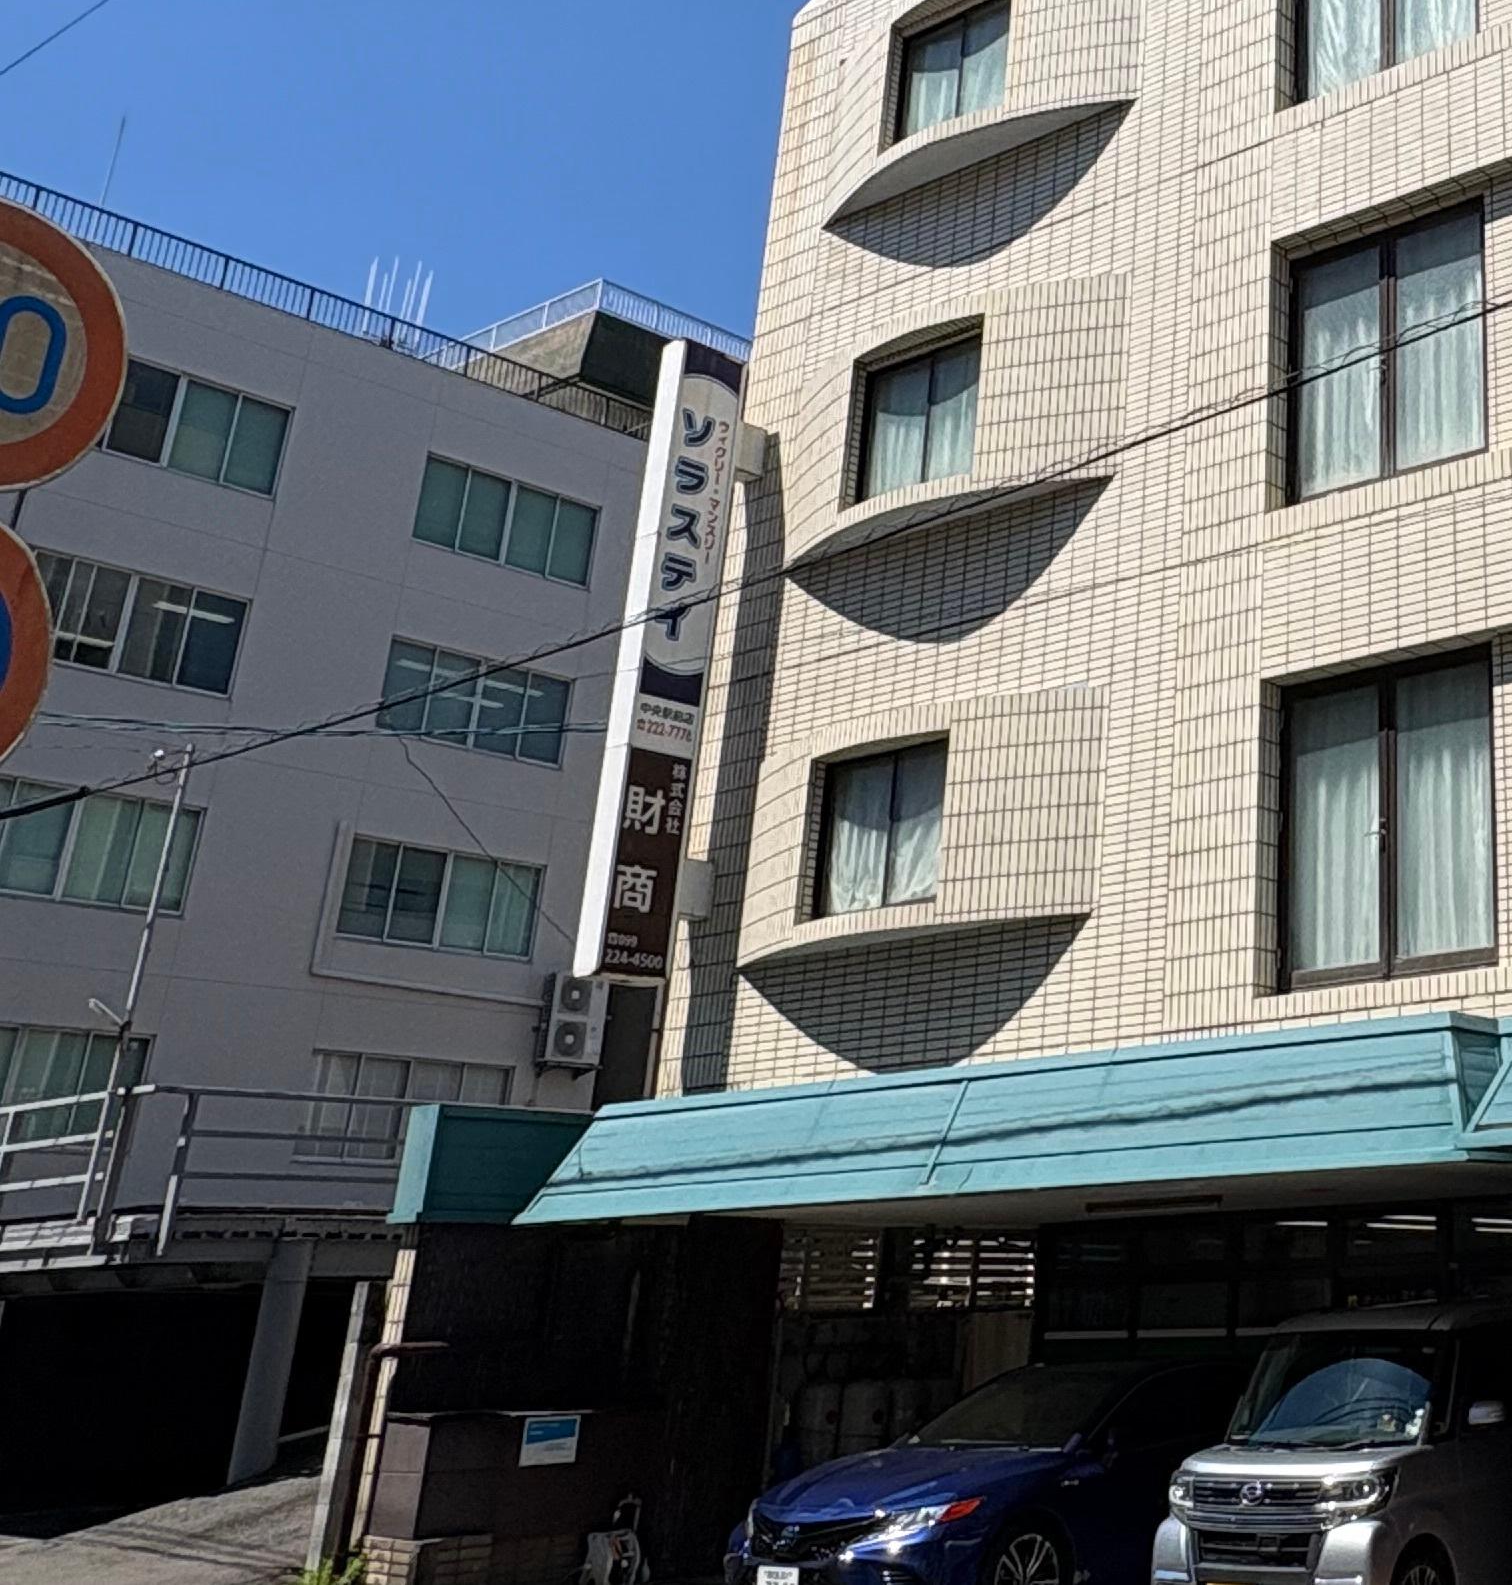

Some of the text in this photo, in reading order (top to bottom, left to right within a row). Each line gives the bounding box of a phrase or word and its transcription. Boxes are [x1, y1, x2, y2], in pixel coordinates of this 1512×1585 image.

[665, 763, 688, 836] 株式会社
[604, 947, 664, 970] 224-4500
